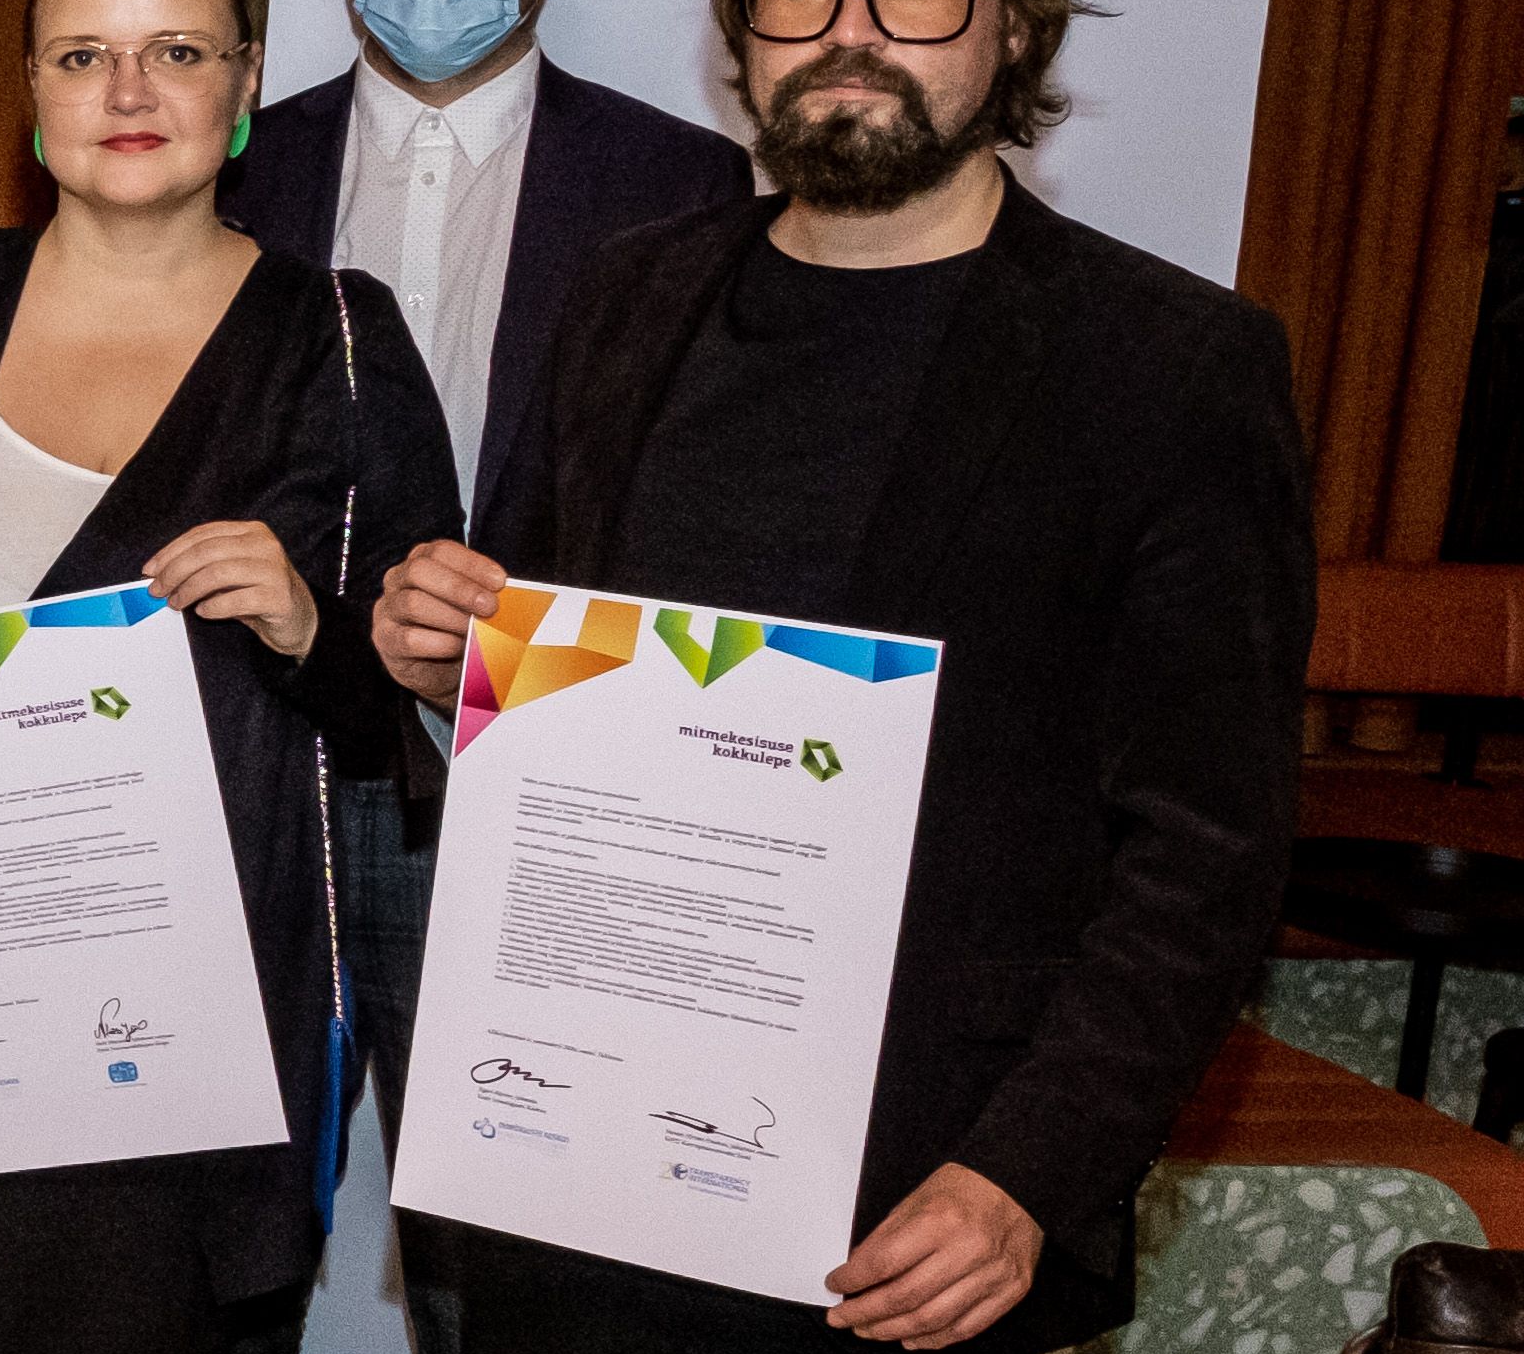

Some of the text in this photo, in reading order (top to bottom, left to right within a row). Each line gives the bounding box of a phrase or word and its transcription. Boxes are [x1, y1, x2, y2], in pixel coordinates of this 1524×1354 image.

[18, 710, 88, 730] kokkulepe
[678, 725, 794, 753] mitmekesisuse
[711, 743, 792, 770] kokkulepe
